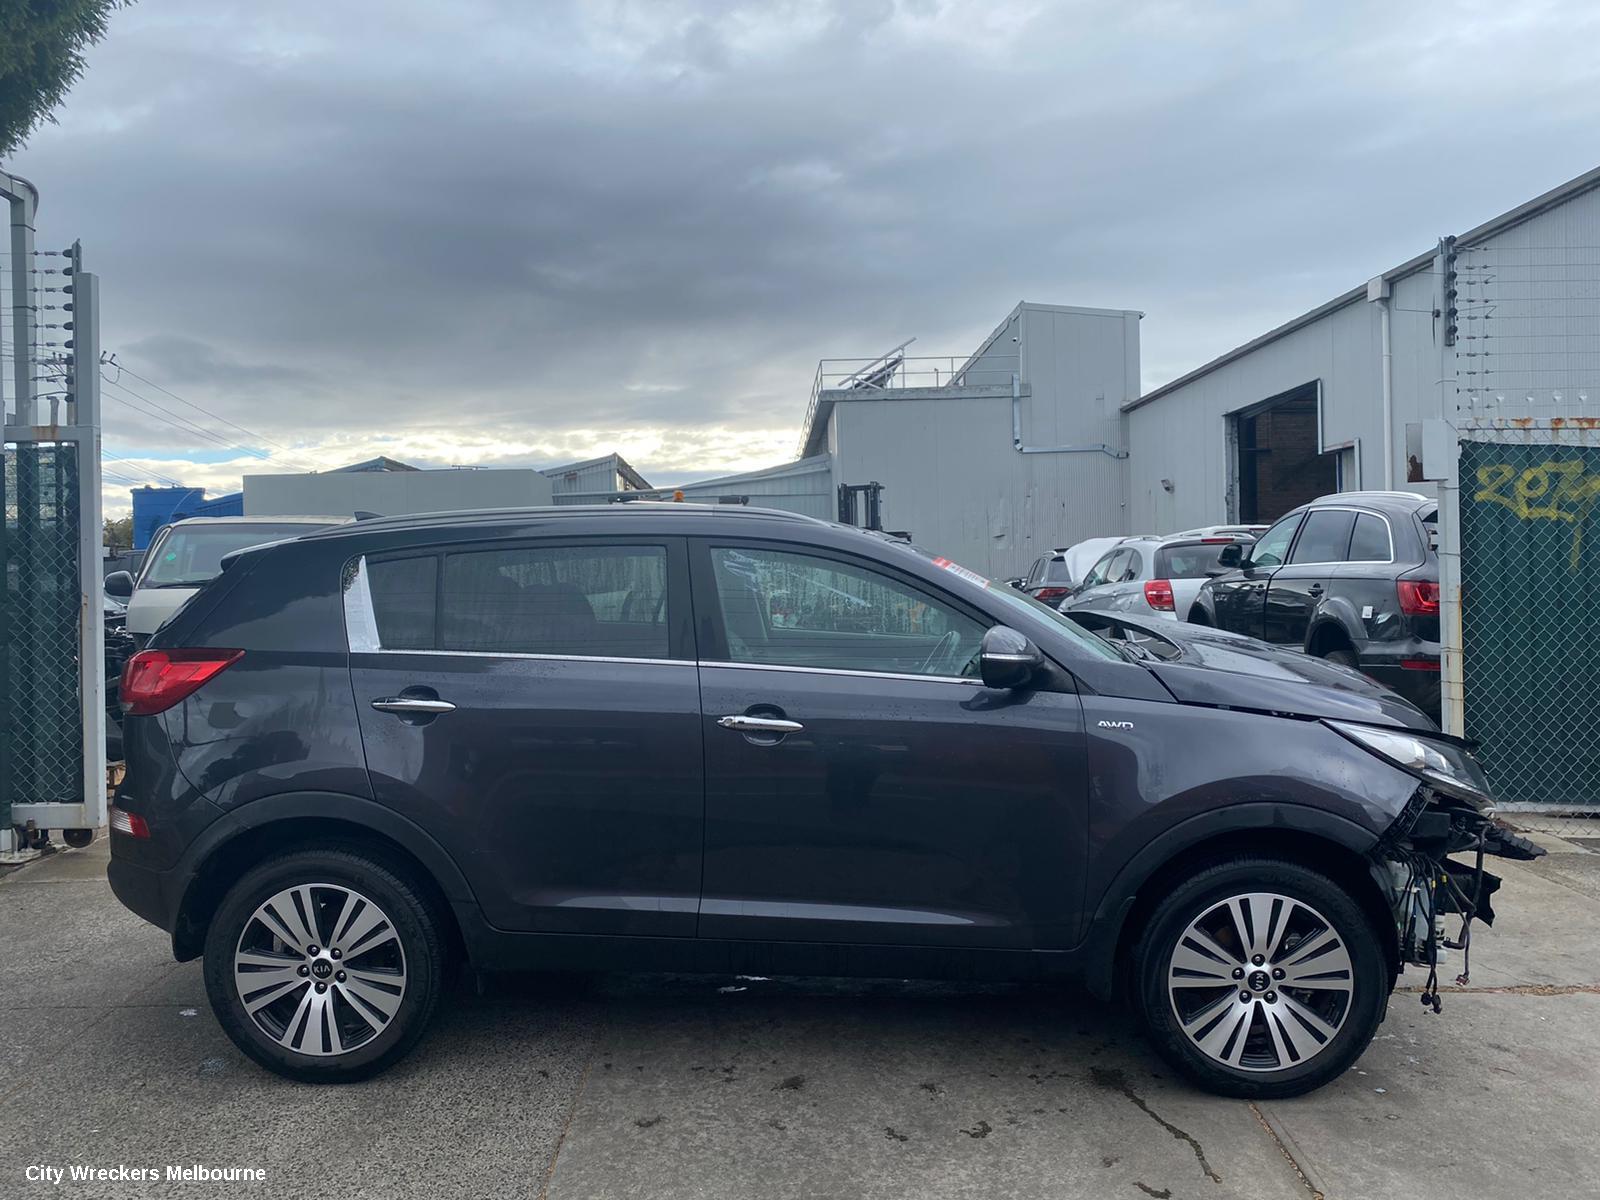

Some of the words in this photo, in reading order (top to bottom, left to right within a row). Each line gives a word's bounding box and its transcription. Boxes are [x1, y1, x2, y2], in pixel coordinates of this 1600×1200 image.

[1098, 720, 1134, 729] AWD
[313, 964, 331, 974] KIA
[1255, 972, 1264, 990] KIA
